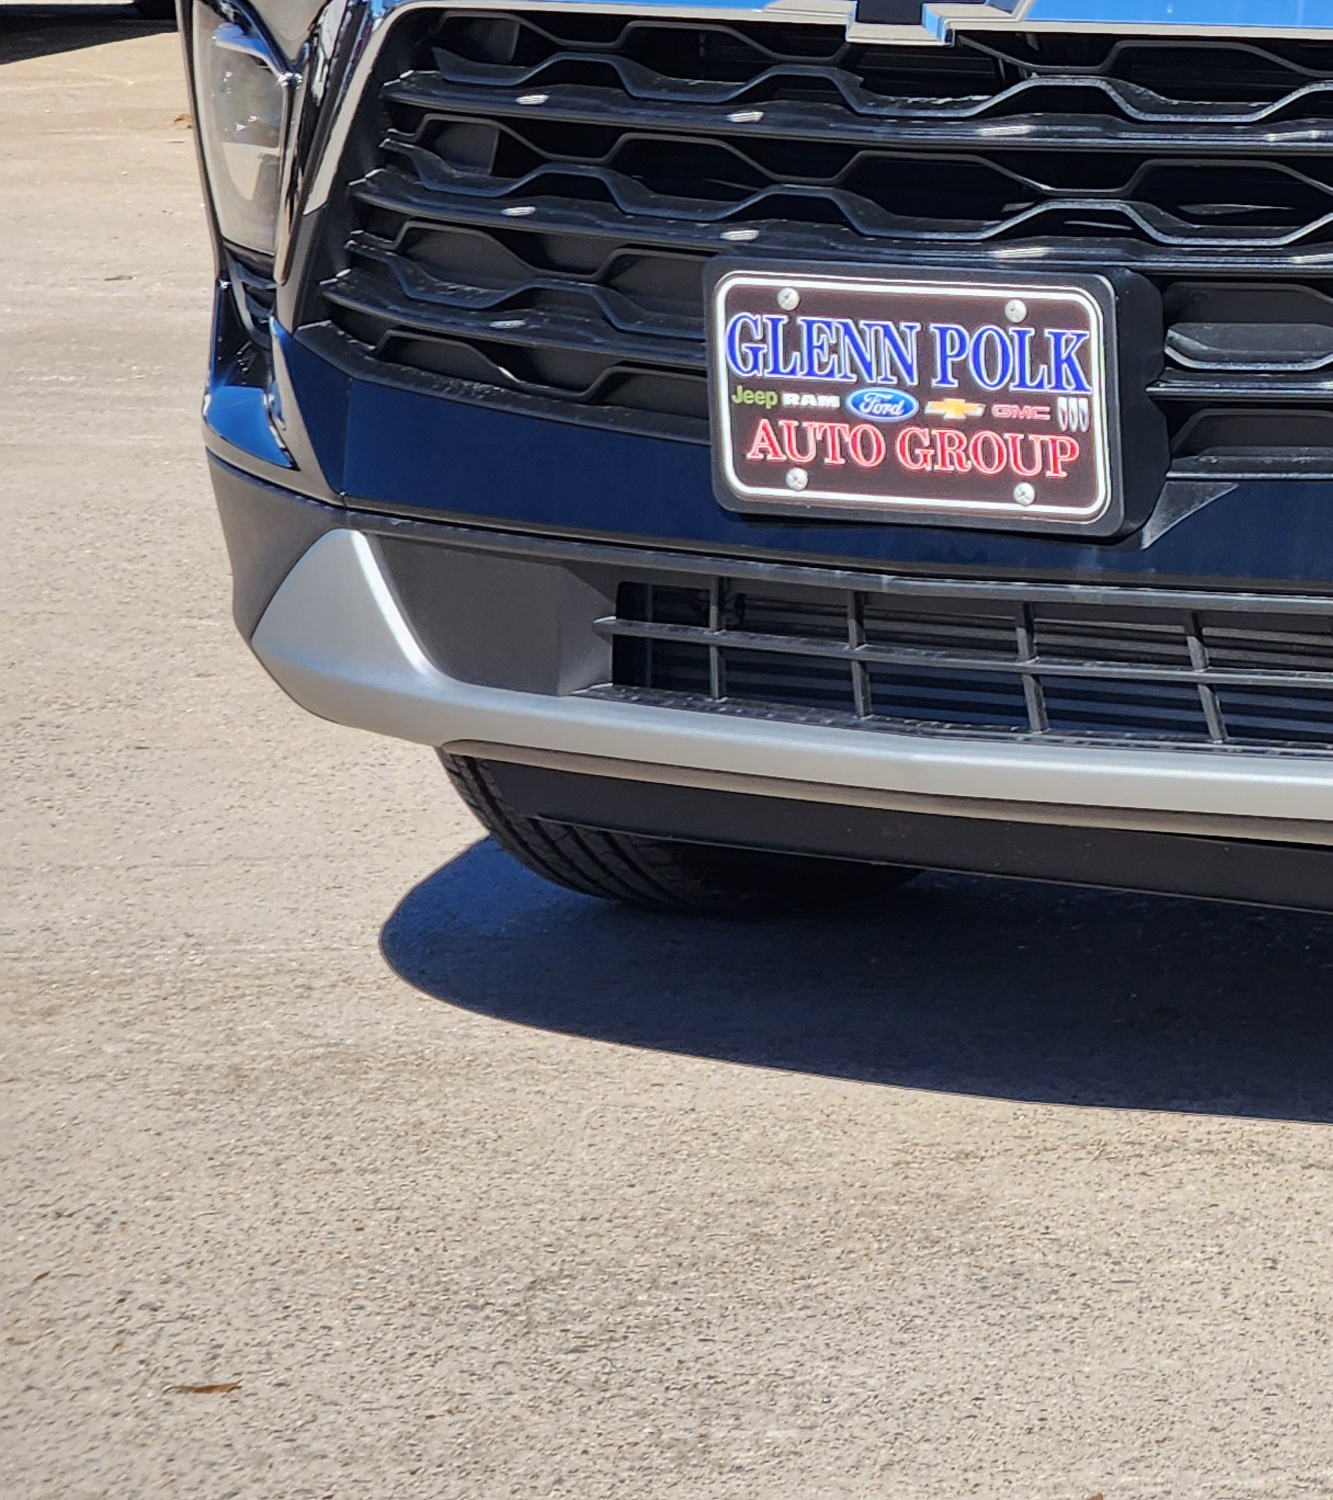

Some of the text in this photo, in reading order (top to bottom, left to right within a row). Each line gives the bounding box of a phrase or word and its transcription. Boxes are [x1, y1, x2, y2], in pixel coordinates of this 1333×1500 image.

[725, 311, 1092, 395] GLENN POLK
[732, 386, 1051, 420] Jeep RAM Ford GMC
[747, 419, 1079, 479] AUTO GROUP
